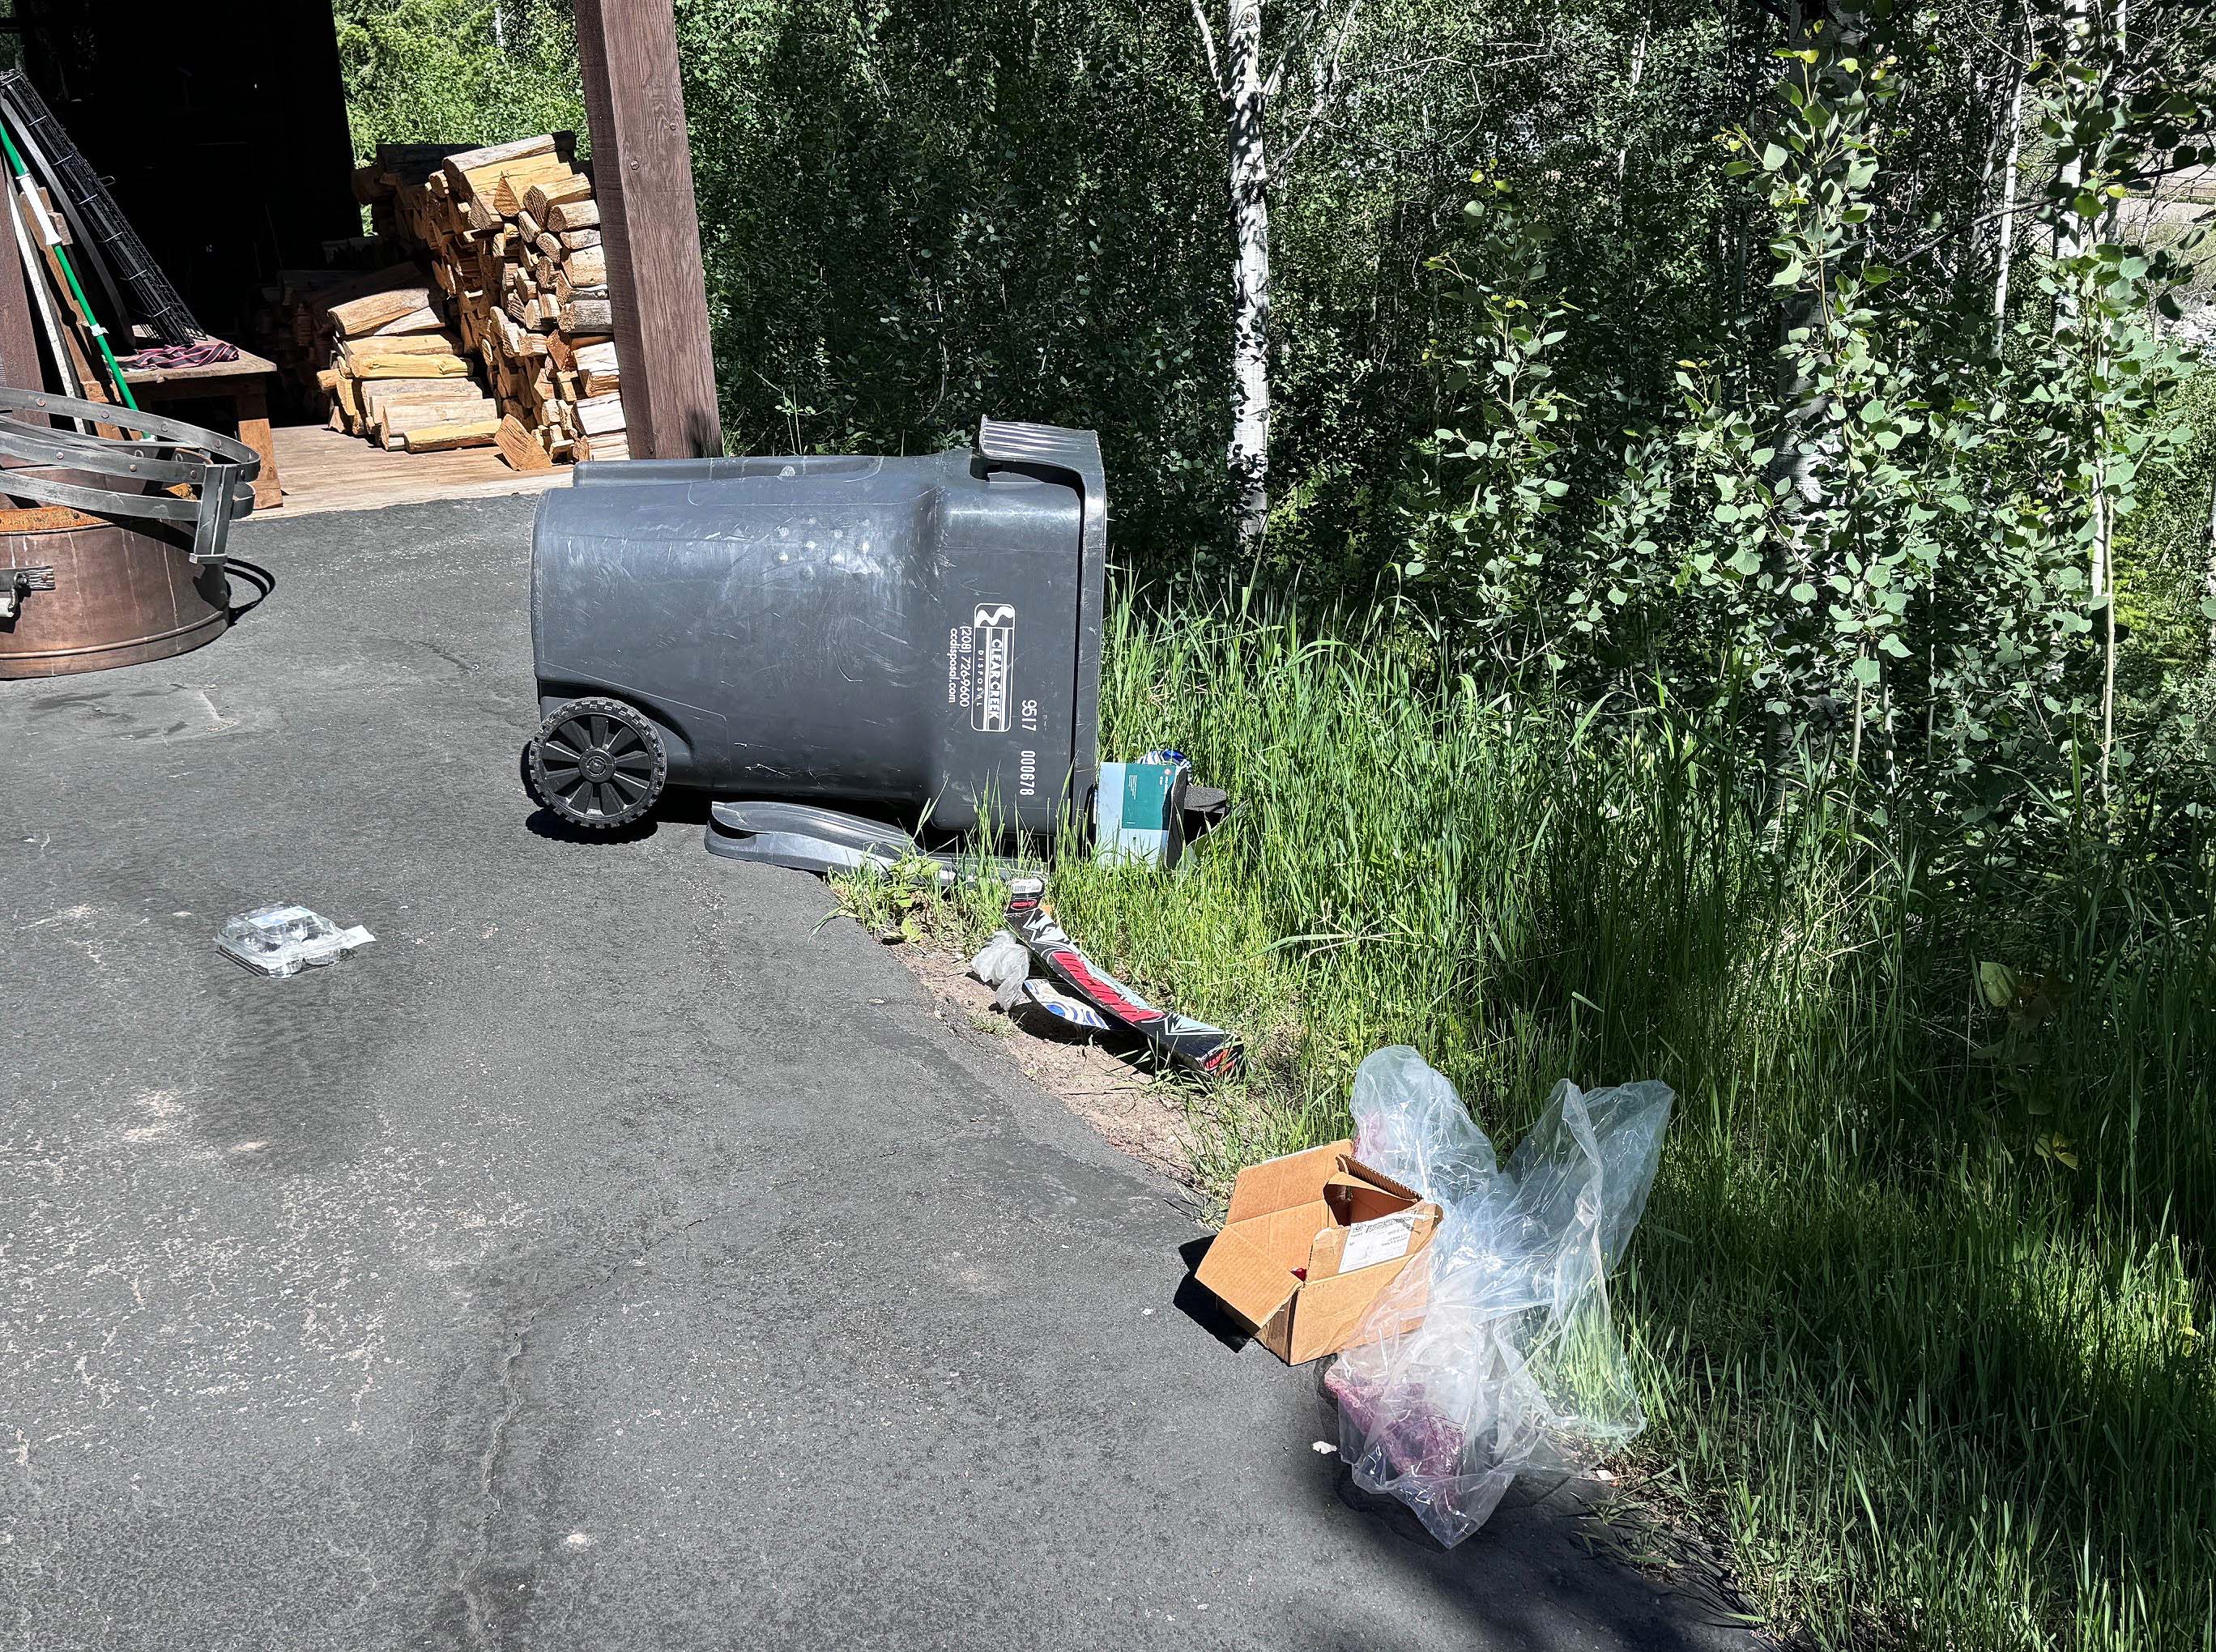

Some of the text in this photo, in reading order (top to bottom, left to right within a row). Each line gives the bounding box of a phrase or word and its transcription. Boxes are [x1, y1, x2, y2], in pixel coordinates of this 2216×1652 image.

[947, 628, 958, 703] ccdisposal.com
[960, 626, 972, 708] (208) 726-9600
[975, 649, 985, 707] DISPOSAL
[989, 638, 1003, 719] CLEAR CREEK
[1019, 699, 1038, 796] 9517 000678
